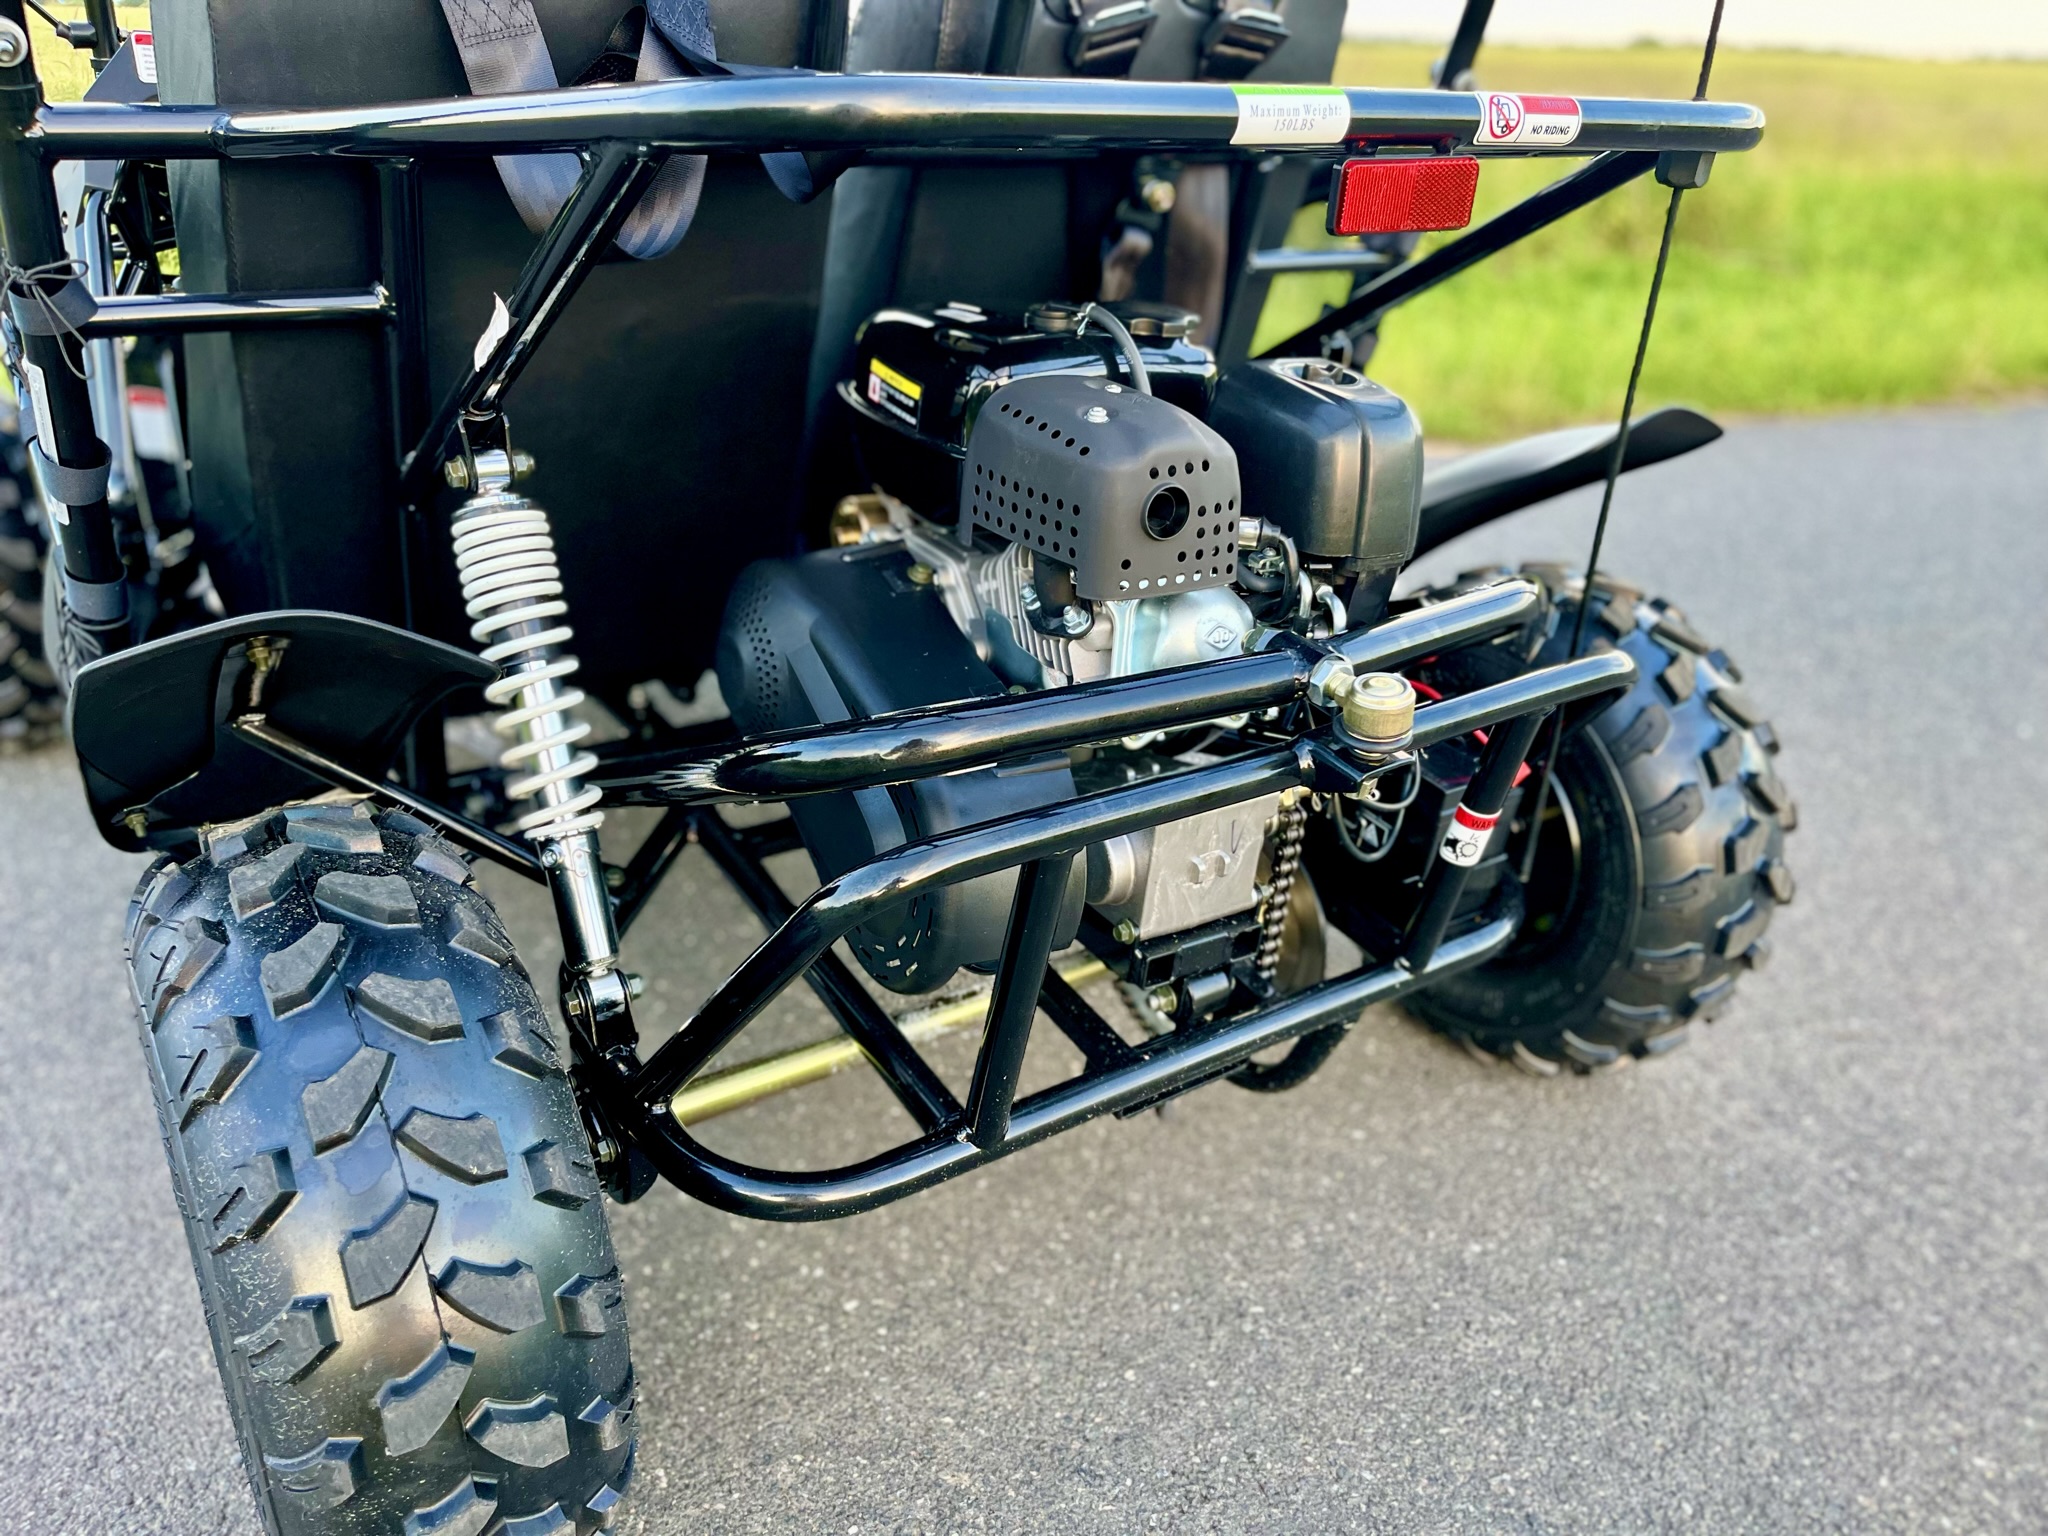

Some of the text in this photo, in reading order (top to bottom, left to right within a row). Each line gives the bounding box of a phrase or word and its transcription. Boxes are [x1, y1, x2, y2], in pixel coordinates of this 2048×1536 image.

[1250, 104, 1342, 119] Maximum Weight:
[1273, 119, 1315, 131] 150LBS
[1530, 125, 1570, 135] NO RIDING
